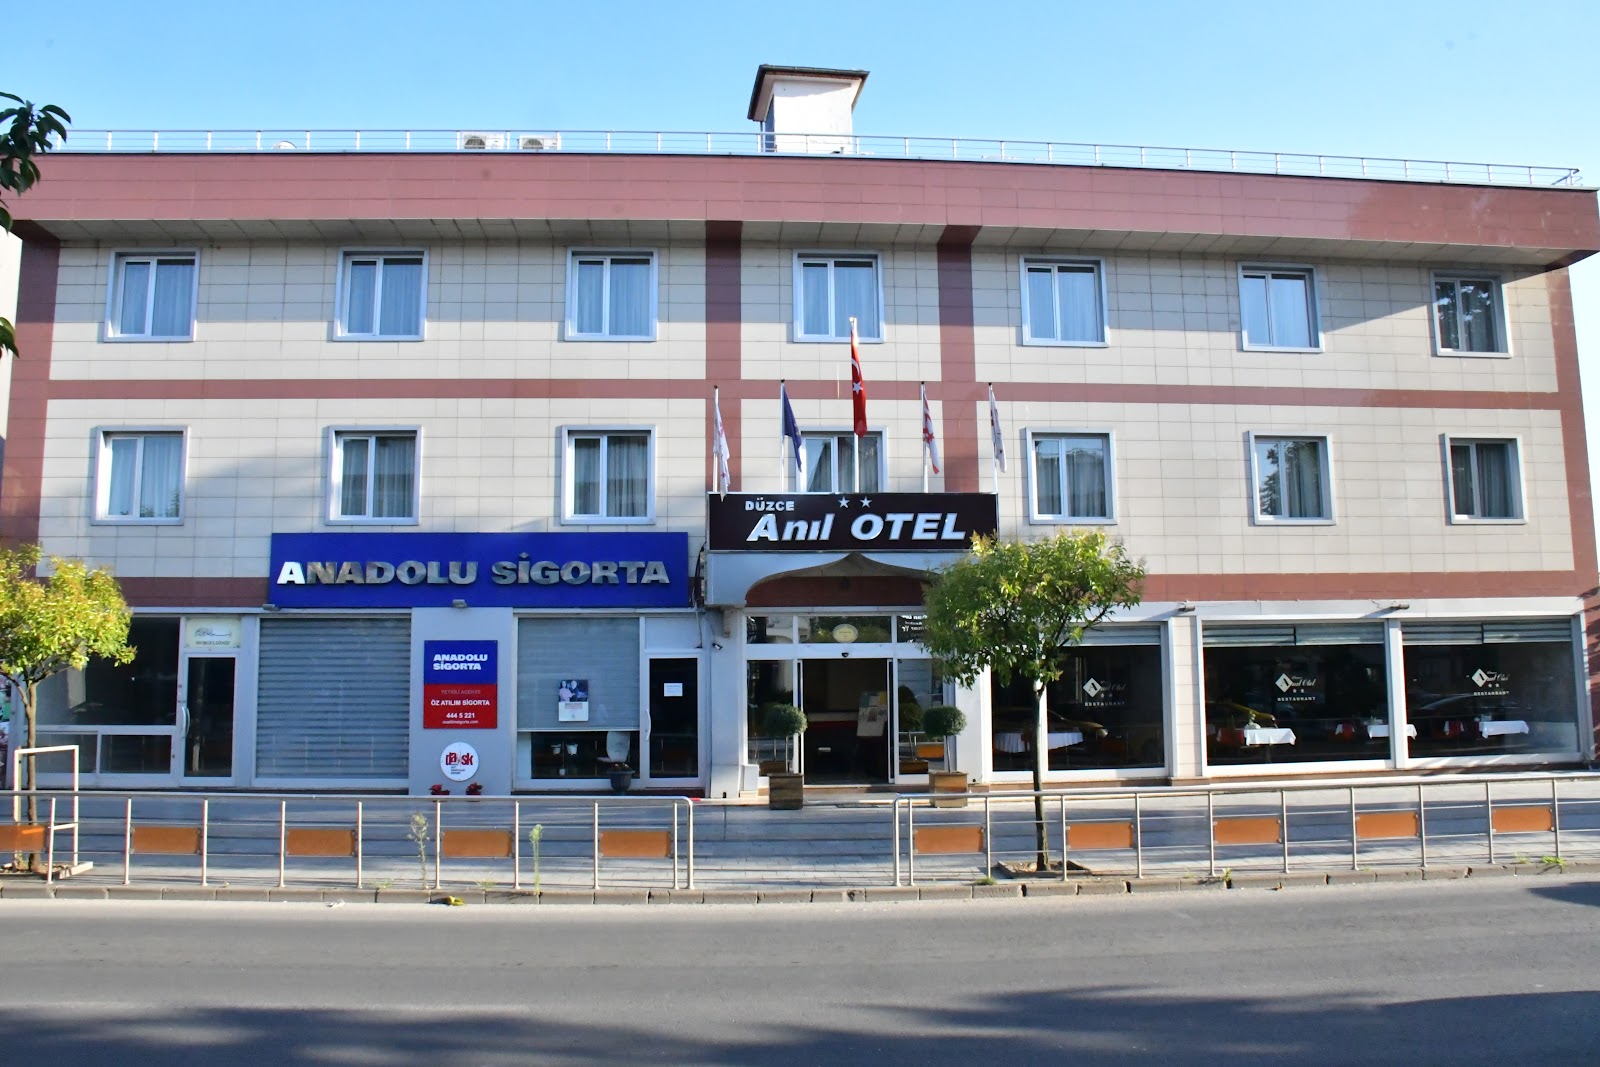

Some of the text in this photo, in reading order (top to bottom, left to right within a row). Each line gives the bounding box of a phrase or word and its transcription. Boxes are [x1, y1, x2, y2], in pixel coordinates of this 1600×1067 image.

[745, 497, 795, 511] DÜZCE
[746, 513, 967, 541] Anıl OTEL
[277, 551, 671, 585] ANADOLU SİGORTA
[433, 660, 482, 670] SİGORTA
